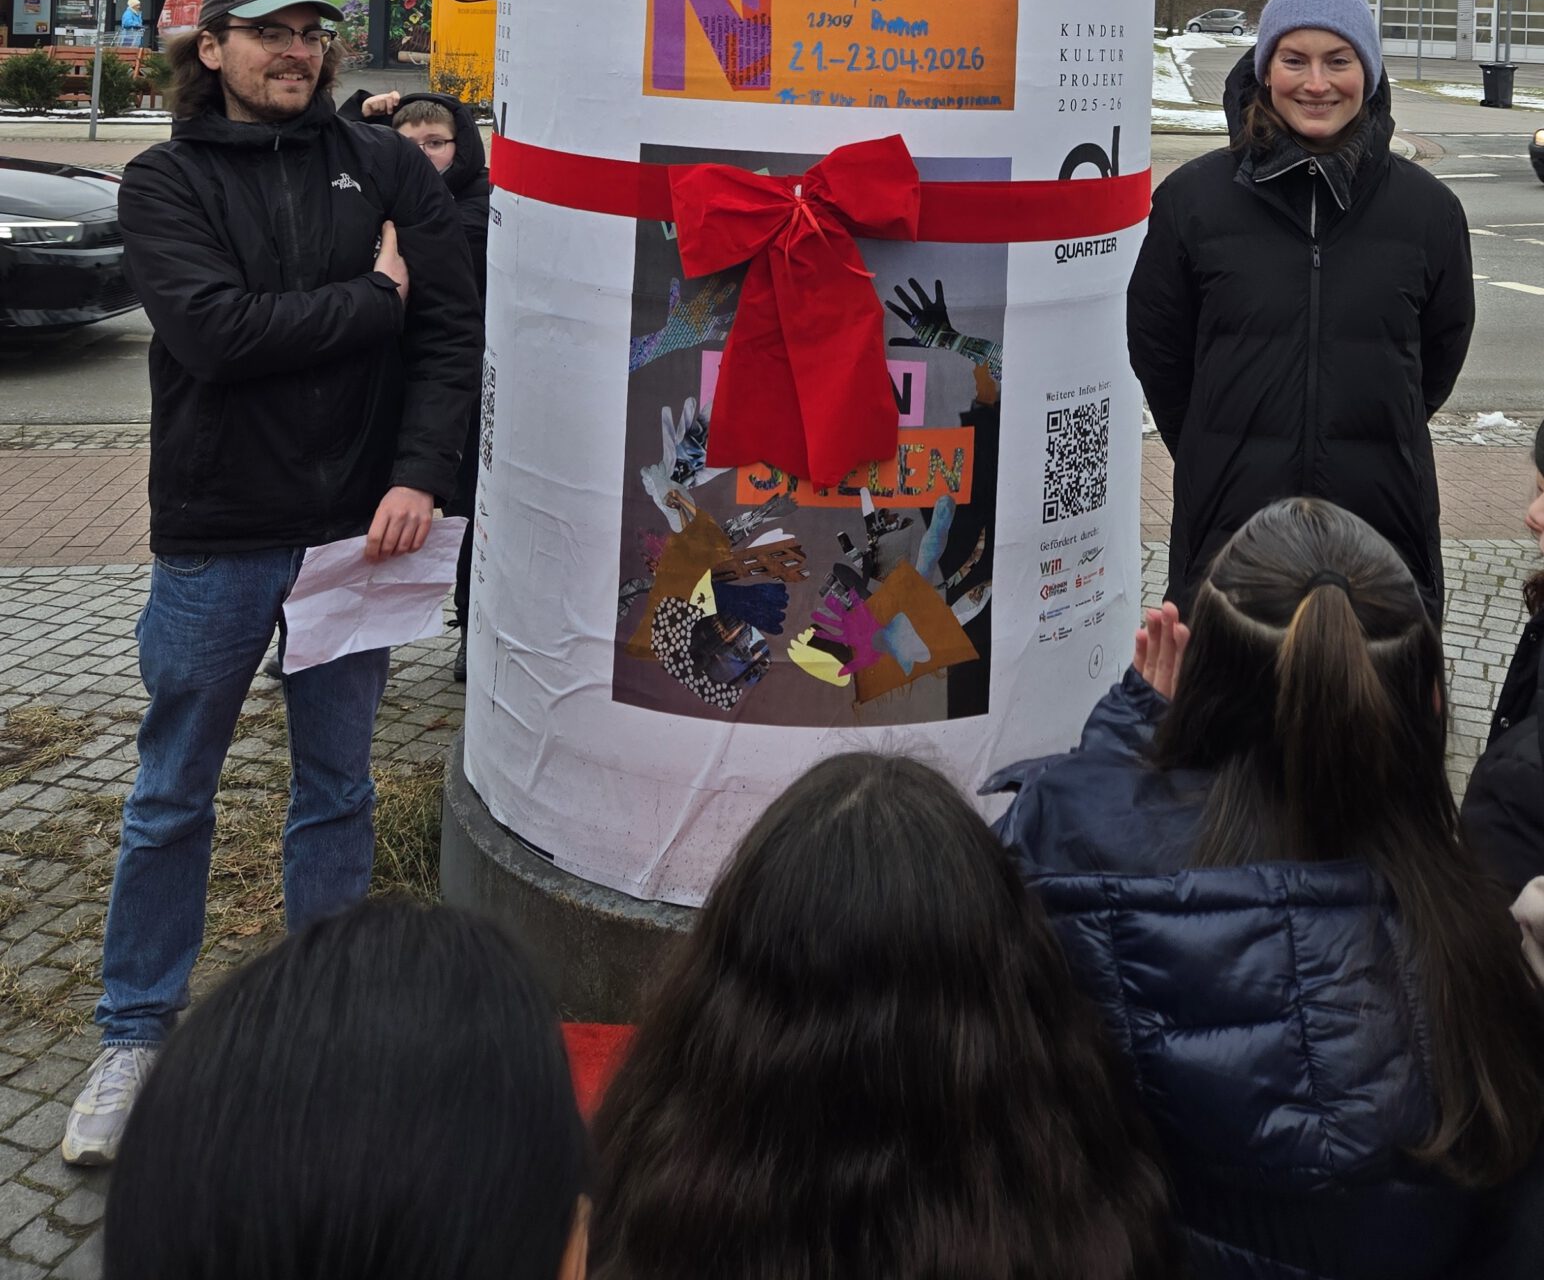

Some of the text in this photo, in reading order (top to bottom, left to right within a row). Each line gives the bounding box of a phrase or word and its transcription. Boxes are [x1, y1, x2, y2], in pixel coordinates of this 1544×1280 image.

[1060, 23, 1125, 38] KINDER
[1059, 48, 1124, 63] KULTUR
[1059, 73, 1124, 87] PROJEKT
[1058, 97, 1122, 112] 2025-26
[1054, 236, 1117, 264] QUARTIER
[1046, 390, 1076, 402] Weitere
[1079, 384, 1097, 396] Infos
[1040, 534, 1077, 552] Gefördert
